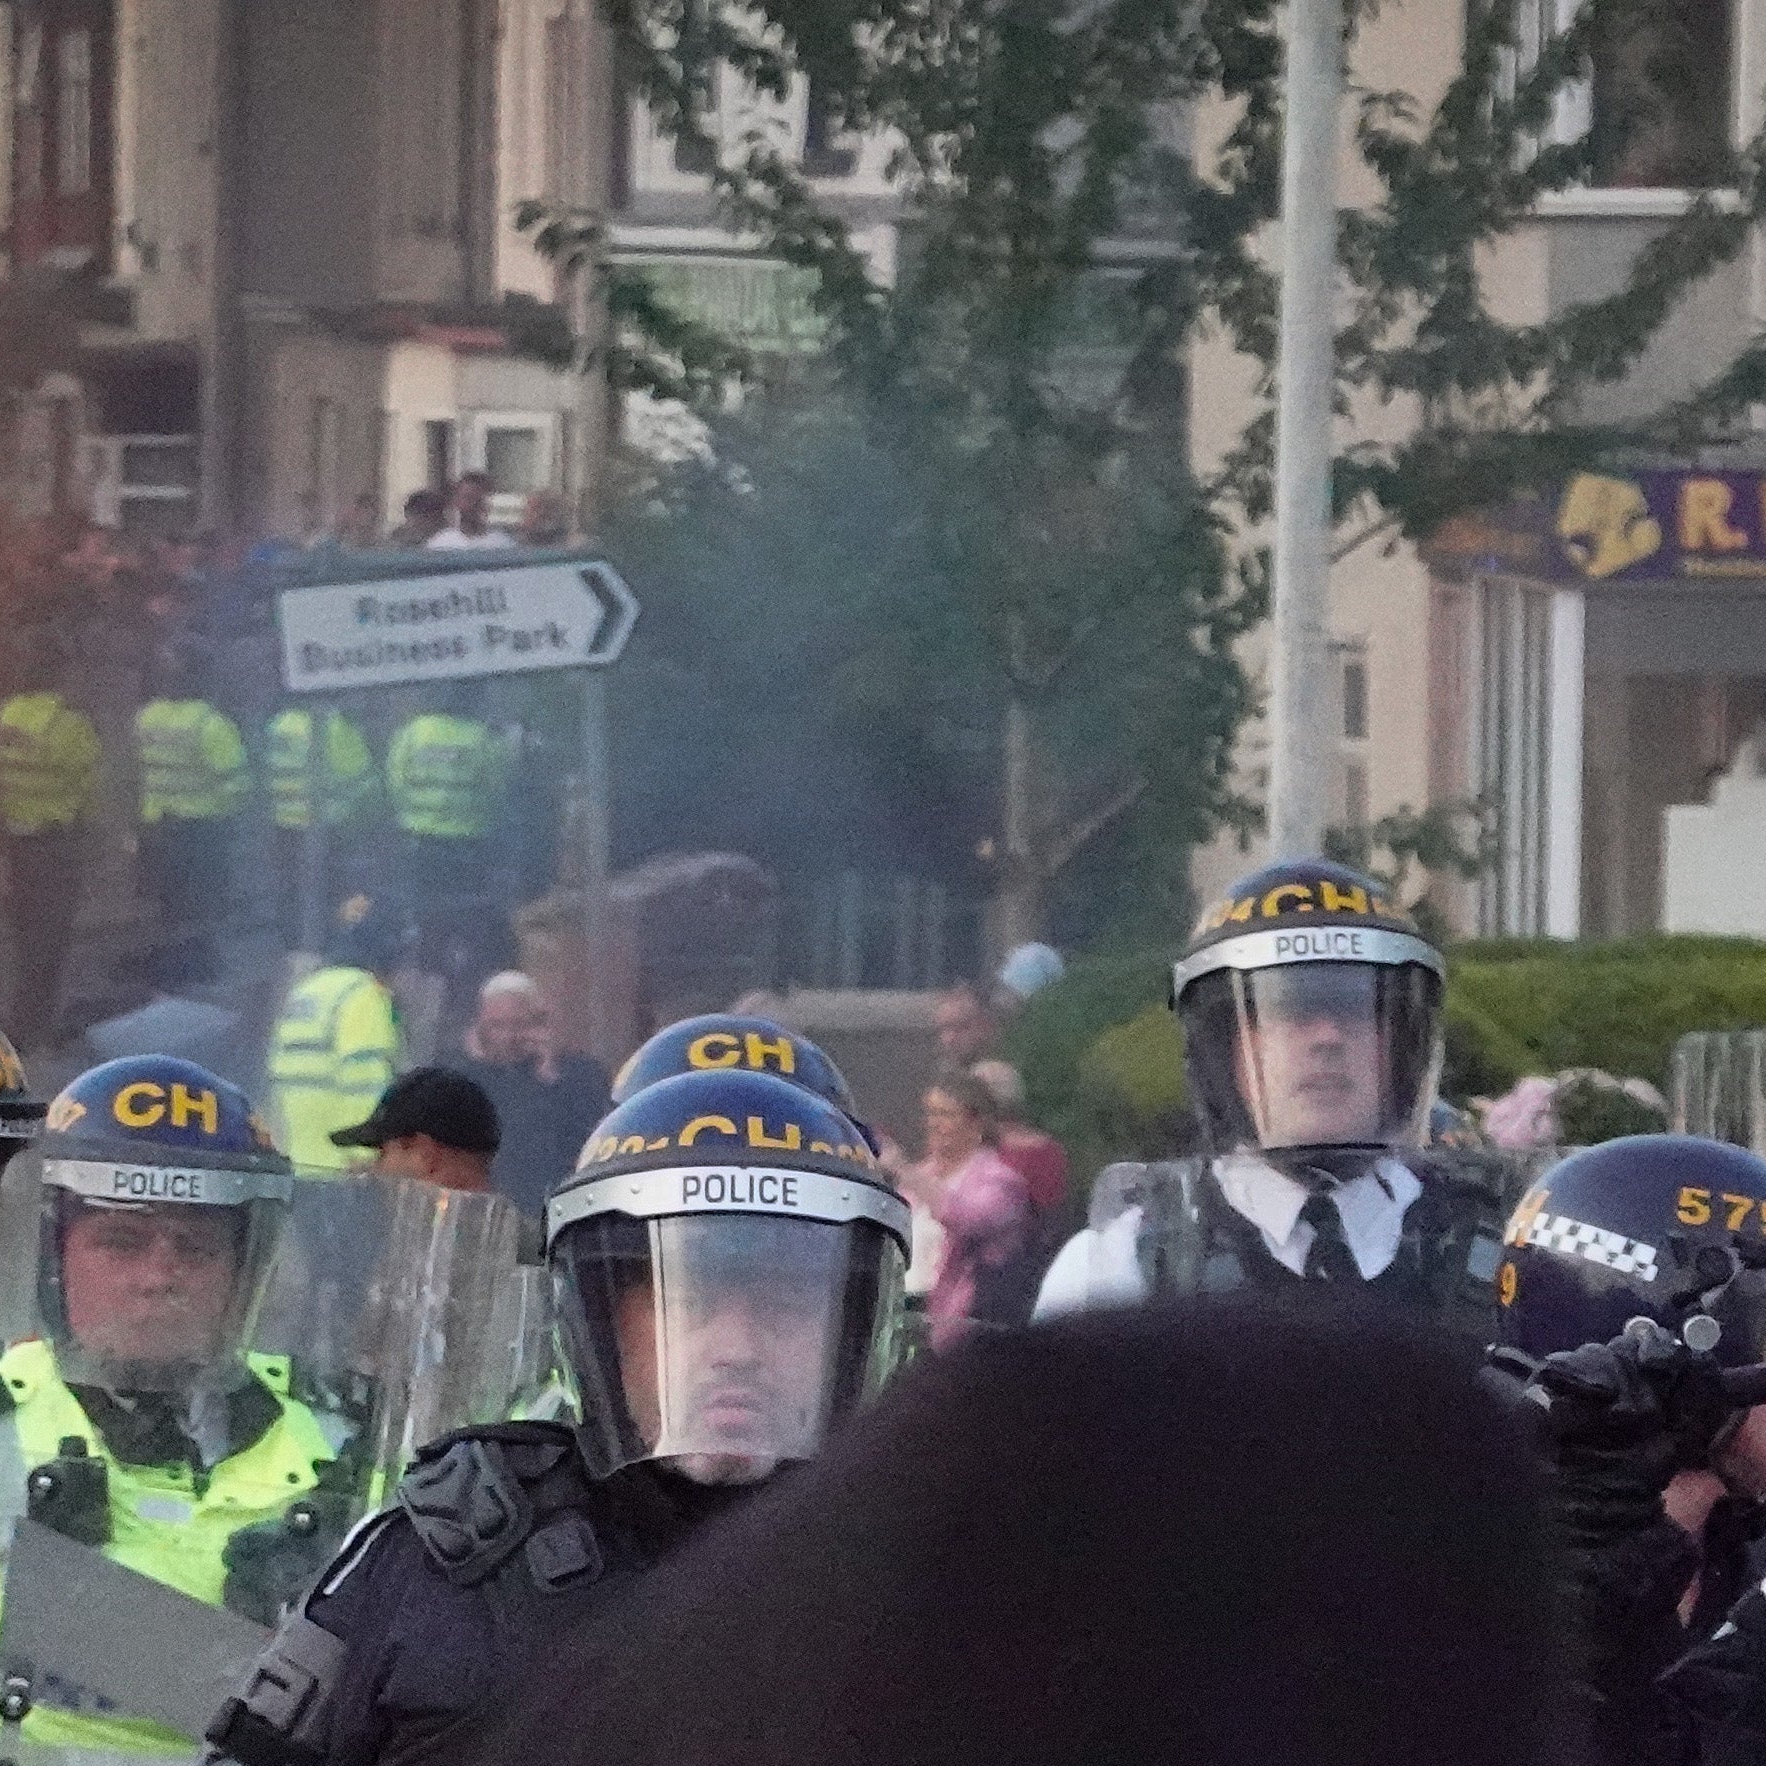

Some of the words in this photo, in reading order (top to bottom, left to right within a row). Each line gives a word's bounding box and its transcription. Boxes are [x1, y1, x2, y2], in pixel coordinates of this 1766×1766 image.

[299, 634, 467, 674] Business
[482, 619, 569, 653] Park
[1261, 881, 1368, 917] CH
[1276, 932, 1365, 957] POLICE
[689, 1033, 795, 1073] CH
[114, 1083, 218, 1134] CH
[114, 1170, 201, 1198] POLICE
[682, 1174, 798, 1205] POLICE
